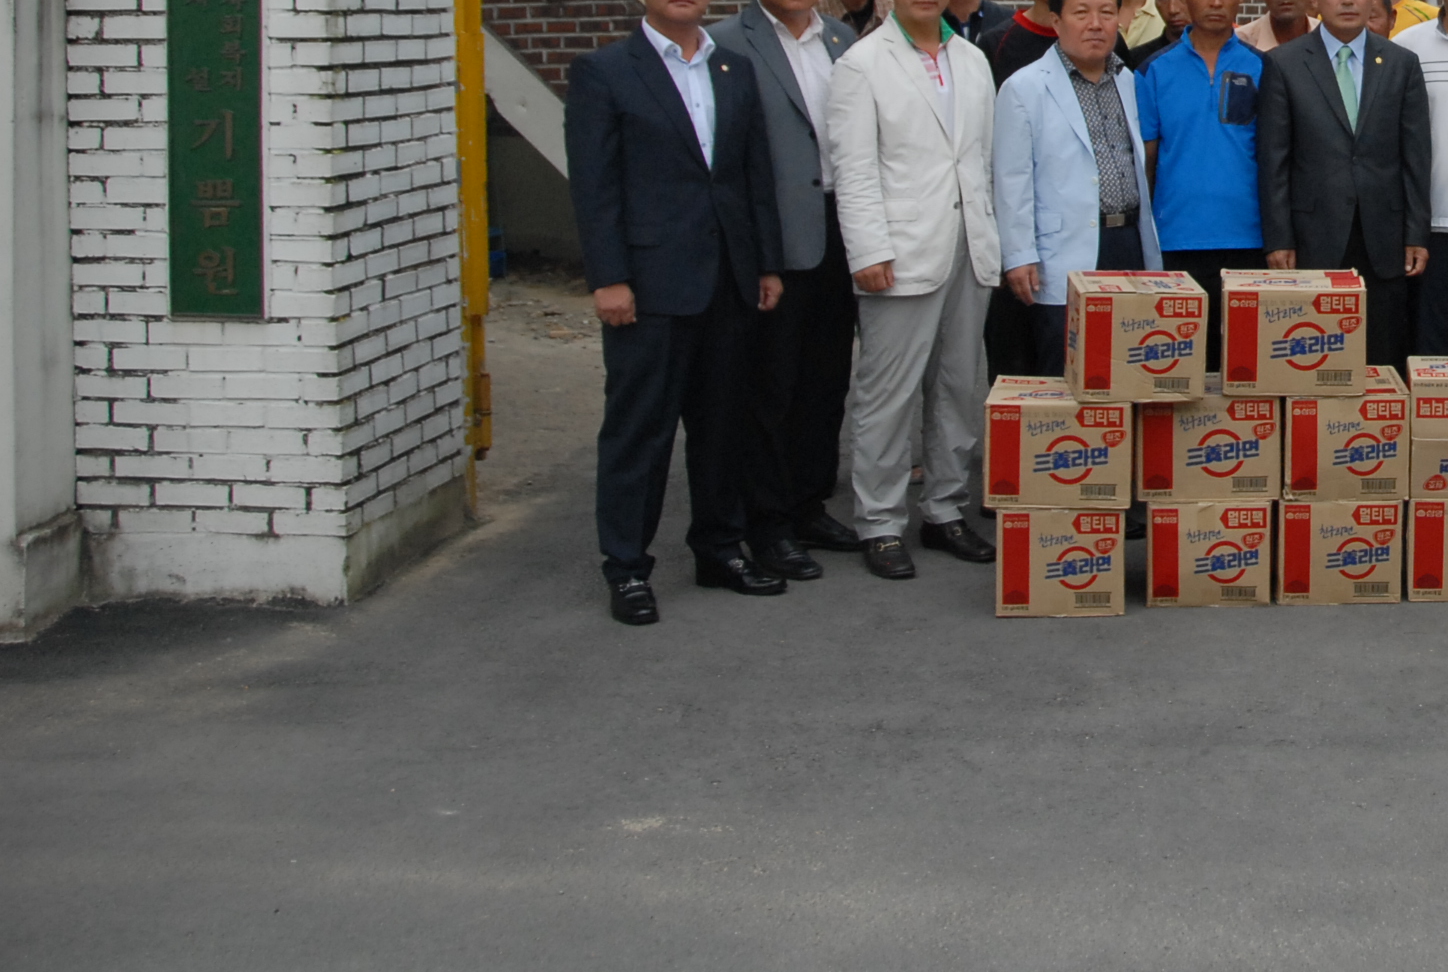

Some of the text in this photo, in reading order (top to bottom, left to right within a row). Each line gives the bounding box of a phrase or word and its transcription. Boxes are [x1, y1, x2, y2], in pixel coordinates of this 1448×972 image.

[191, 108, 242, 296] 기쁨원
[1162, 299, 1199, 316] 멀티팩
[1320, 296, 1357, 312] 멀티팩
[1083, 409, 1120, 425] 멀티팩
[1234, 402, 1270, 419] 멀티팩
[1366, 402, 1402, 419] 멀티팩
[1080, 516, 1116, 532] 멀티팩
[1228, 510, 1264, 527] 멀티팩
[1360, 507, 1396, 524] 멀티팩
